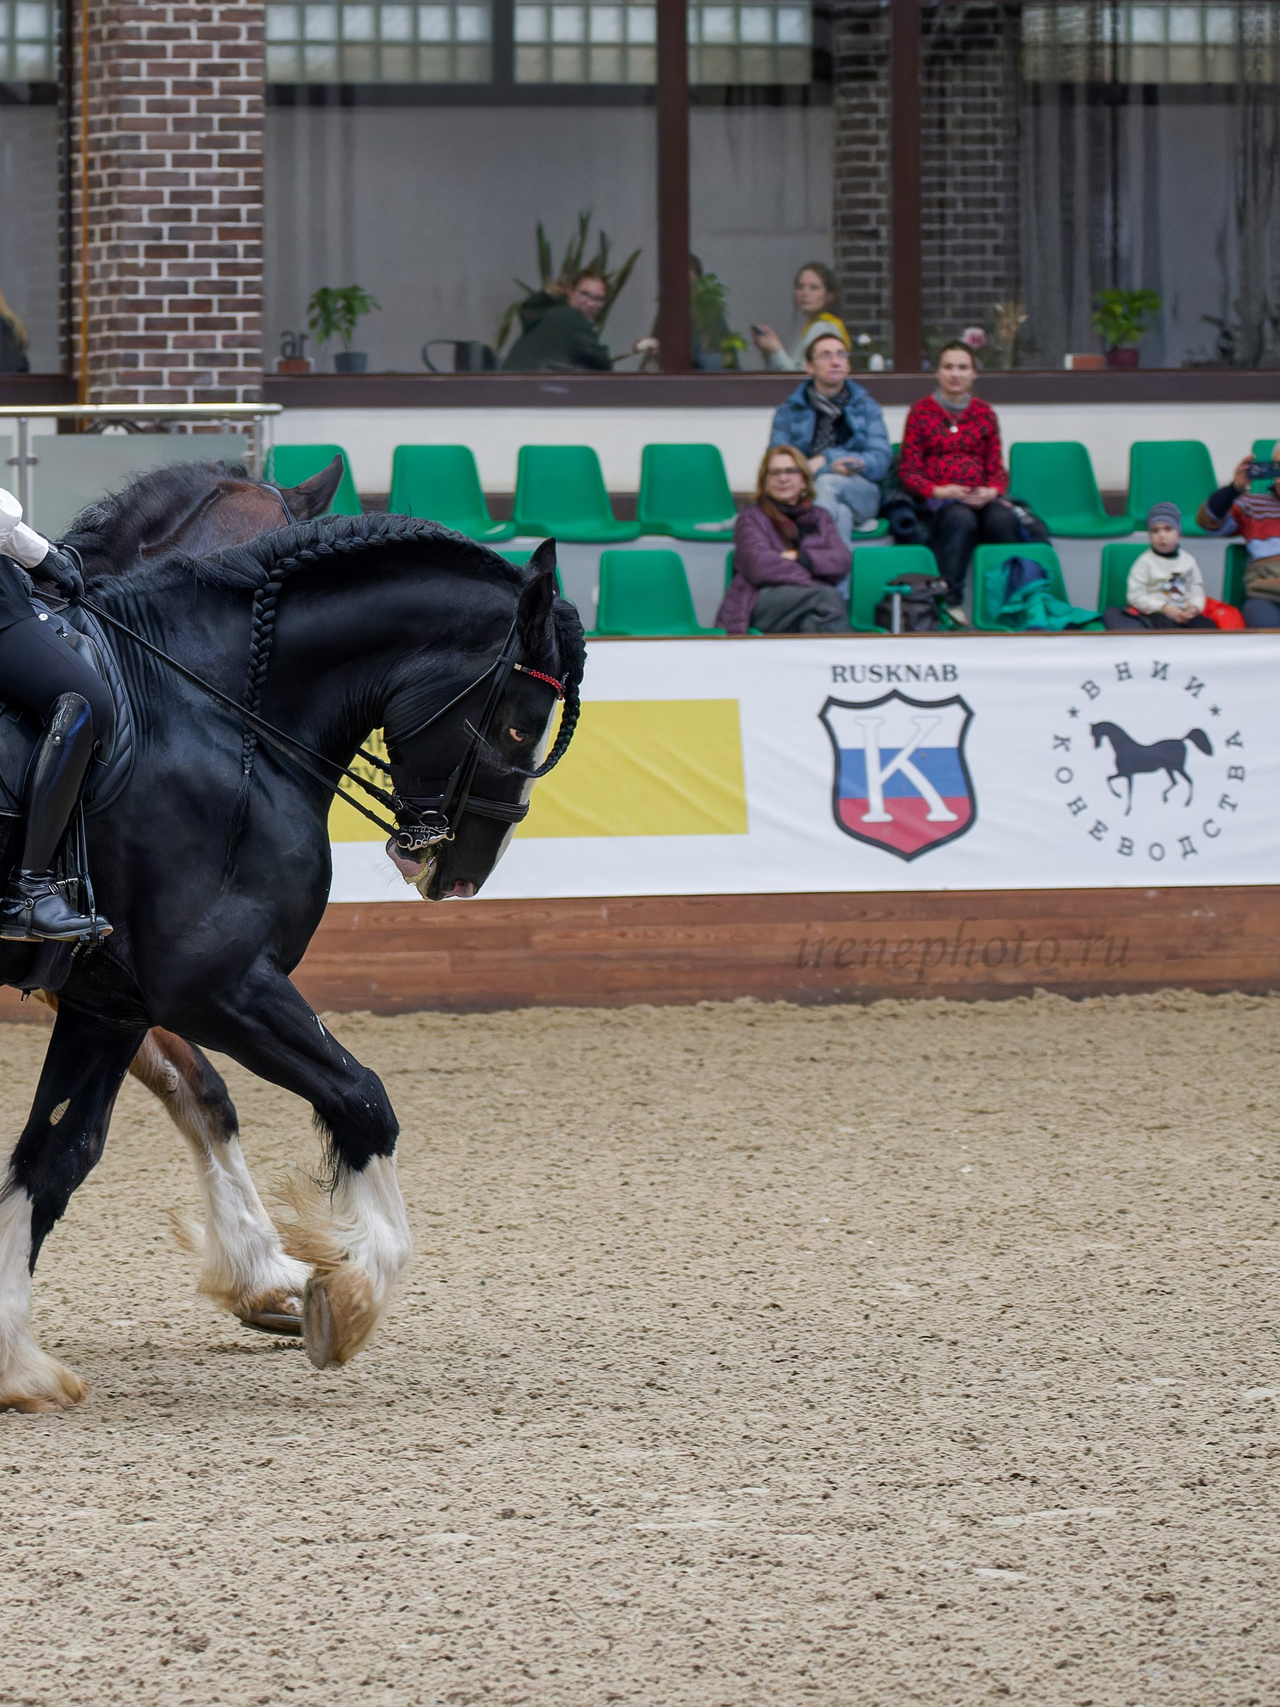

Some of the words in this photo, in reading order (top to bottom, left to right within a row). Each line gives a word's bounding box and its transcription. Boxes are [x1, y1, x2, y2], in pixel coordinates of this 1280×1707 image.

[830, 664, 959, 683] RUSKNAB
[1080, 660, 1206, 701] ВНИИ
[854, 715, 959, 823] K
[1052, 729, 1246, 862] КОНЕВОДСТВА
